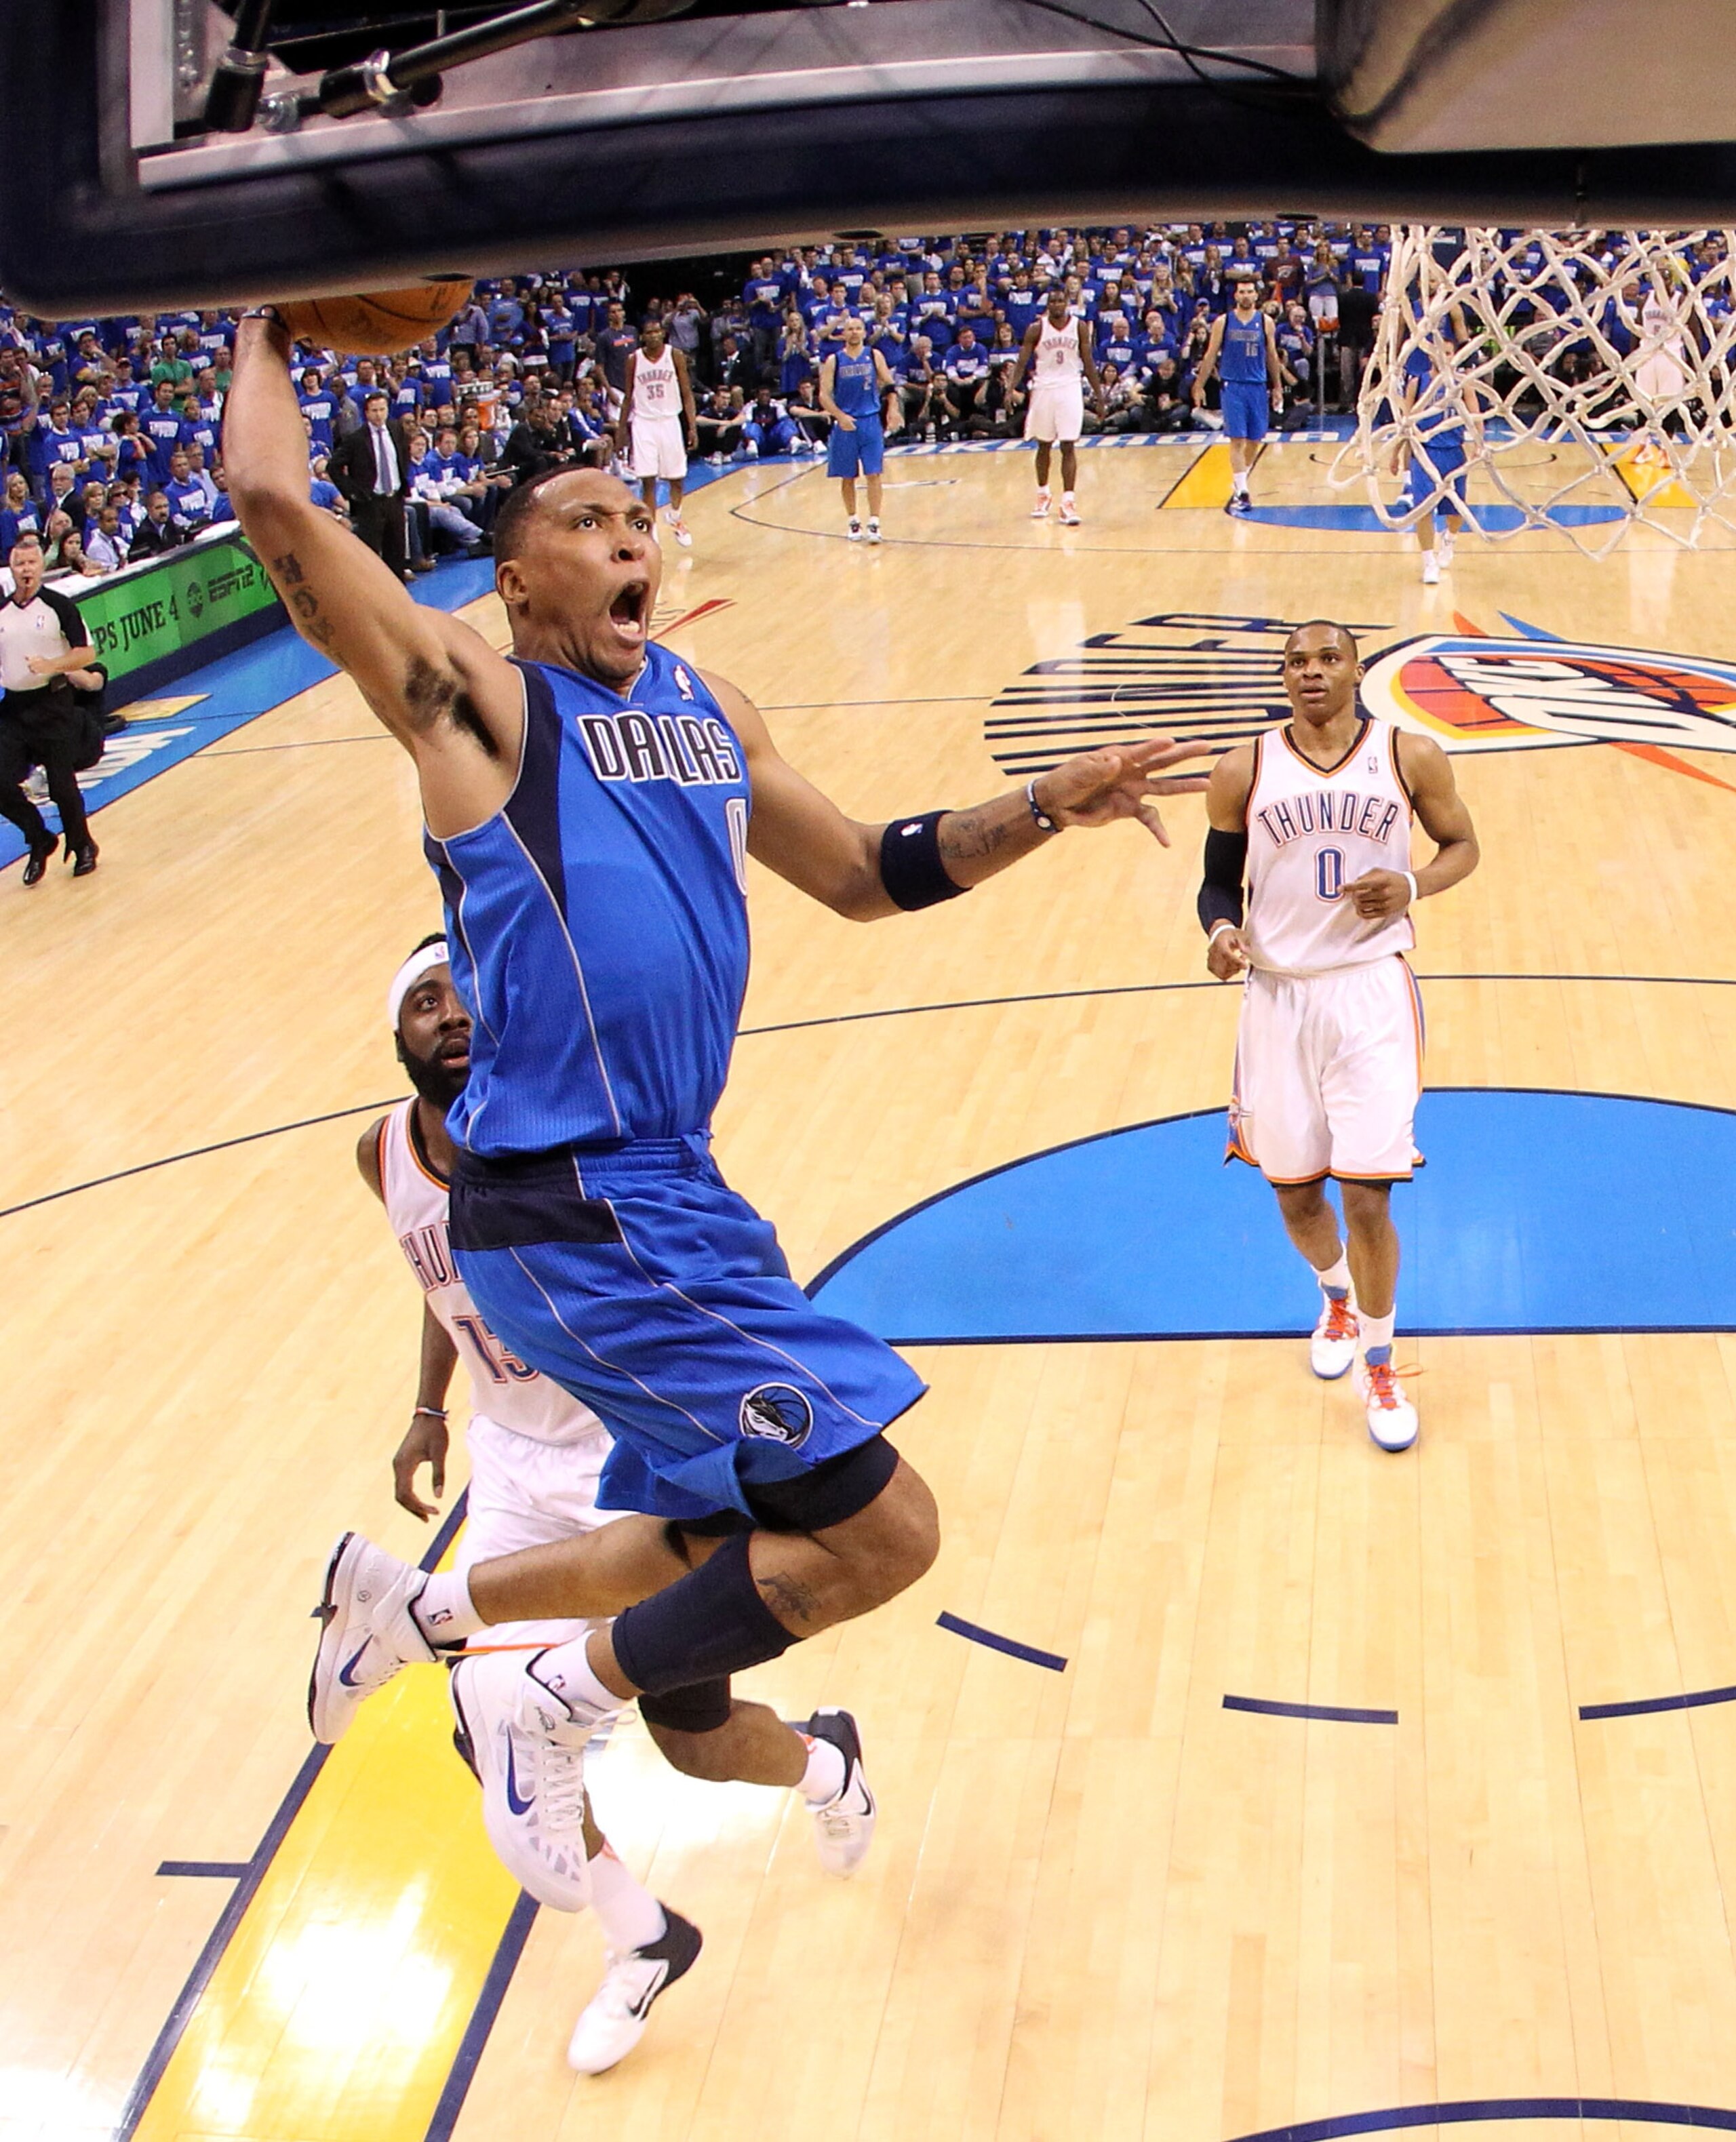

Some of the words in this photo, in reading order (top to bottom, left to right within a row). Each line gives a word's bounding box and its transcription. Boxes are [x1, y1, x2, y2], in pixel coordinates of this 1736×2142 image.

[1056, 350, 1064, 365] 9
[646, 383, 665, 400] 35
[120, 599, 166, 652] JUNE
[169, 594, 179, 621] 4
[576, 711, 743, 787] DALLAS
[1255, 791, 1401, 847] THUNDER
[1314, 845, 1345, 903] 0
